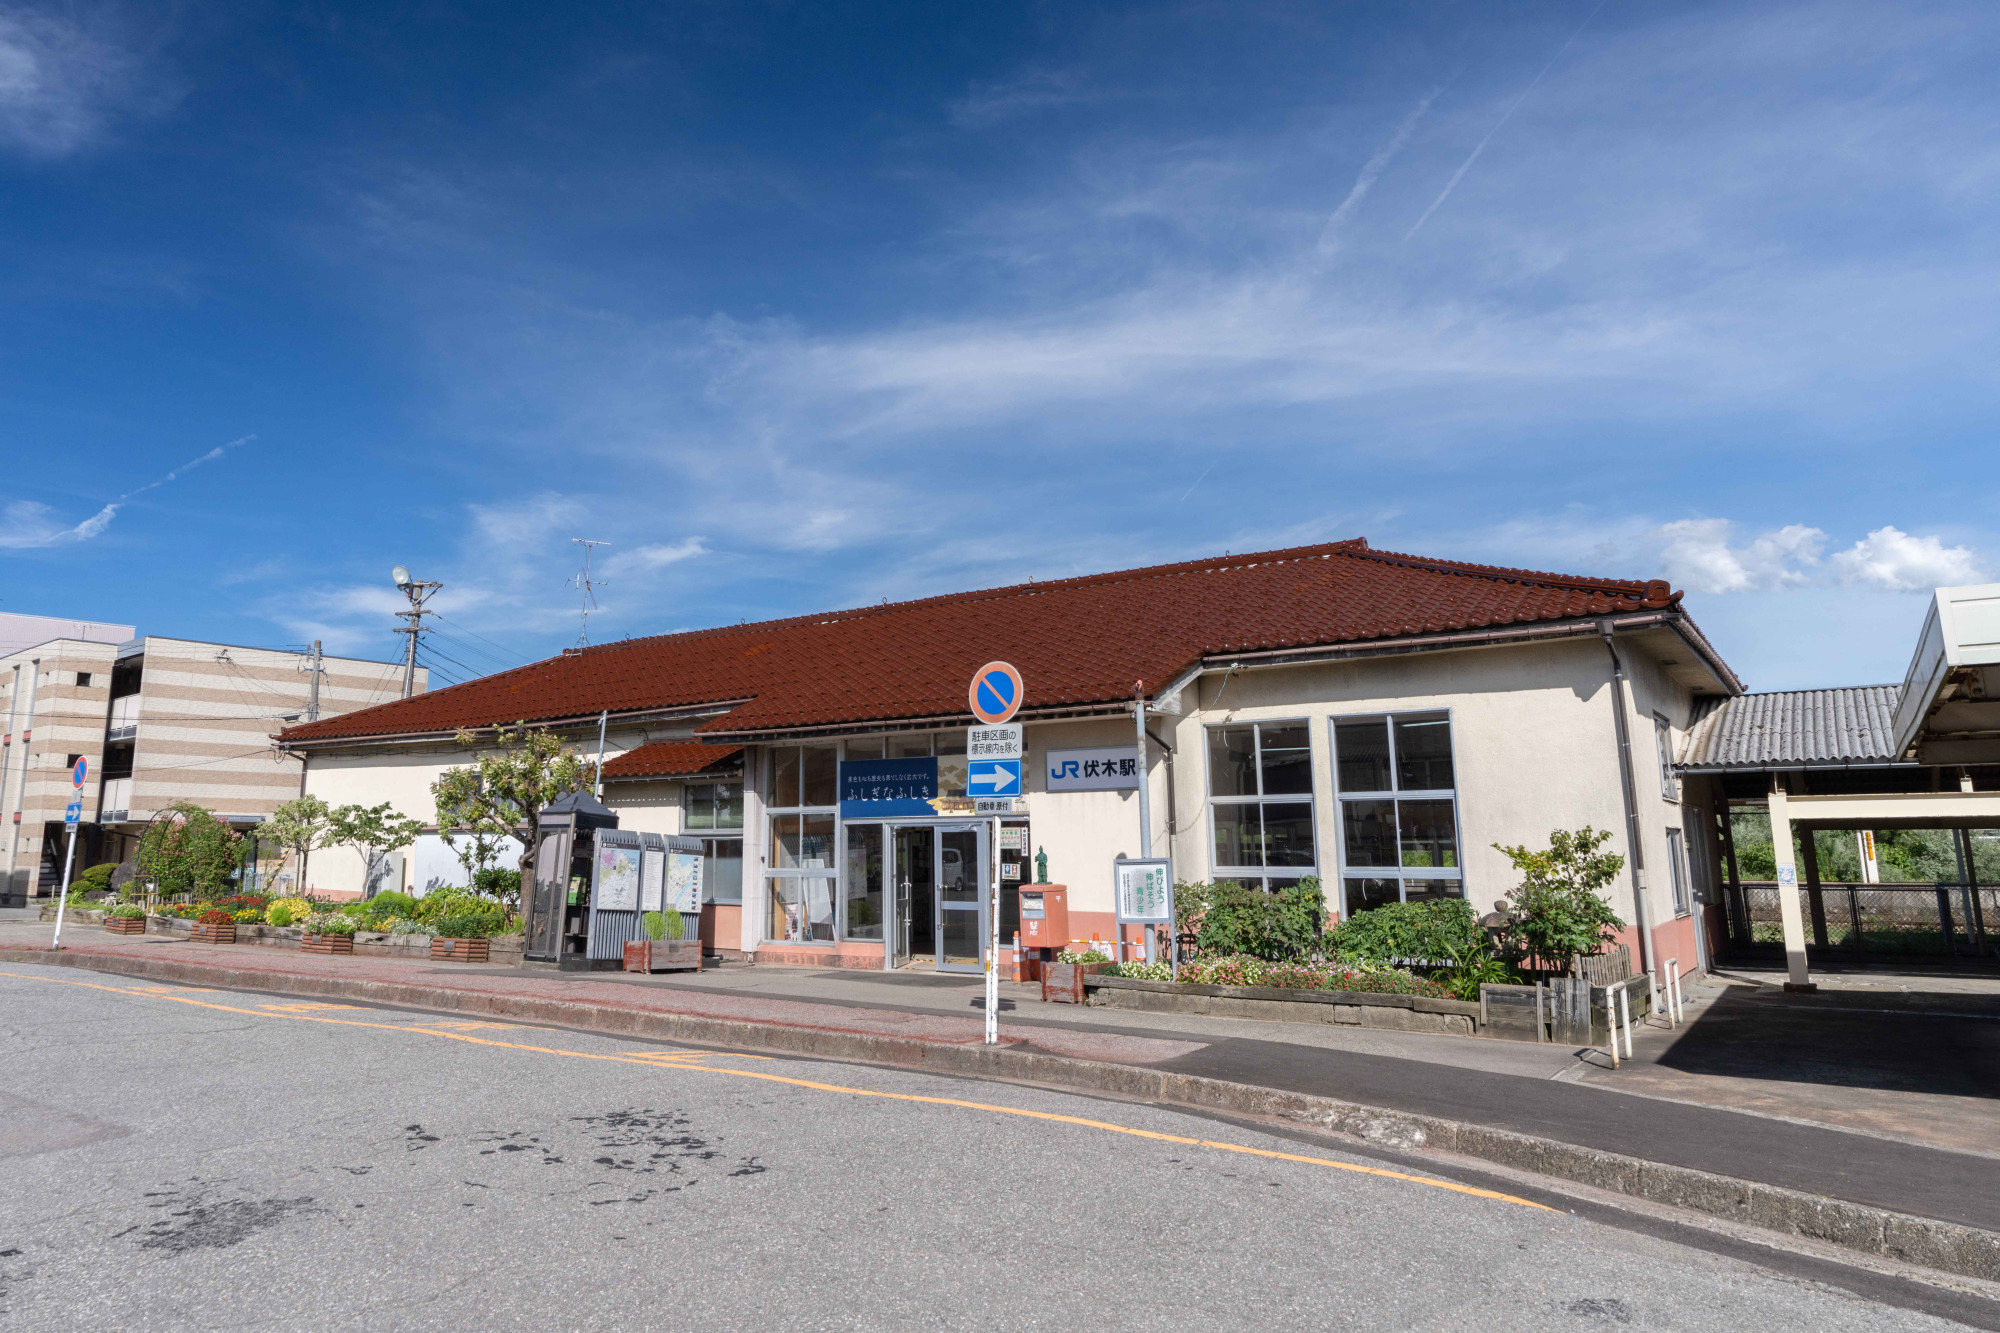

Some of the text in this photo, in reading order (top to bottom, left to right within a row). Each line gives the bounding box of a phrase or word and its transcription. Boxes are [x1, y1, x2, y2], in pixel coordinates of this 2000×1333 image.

[971, 729, 1017, 742] 駐車区画の
[971, 742, 1018, 755] 標示線内を除く
[1051, 758, 1136, 779] JR 伏木駅
[847, 785, 929, 802] ふしぎなふしき
[1146, 872, 1155, 909] 伸ばそう
[1155, 868, 1165, 904] 伸びよう
[1136, 886, 1145, 914] 青少年
